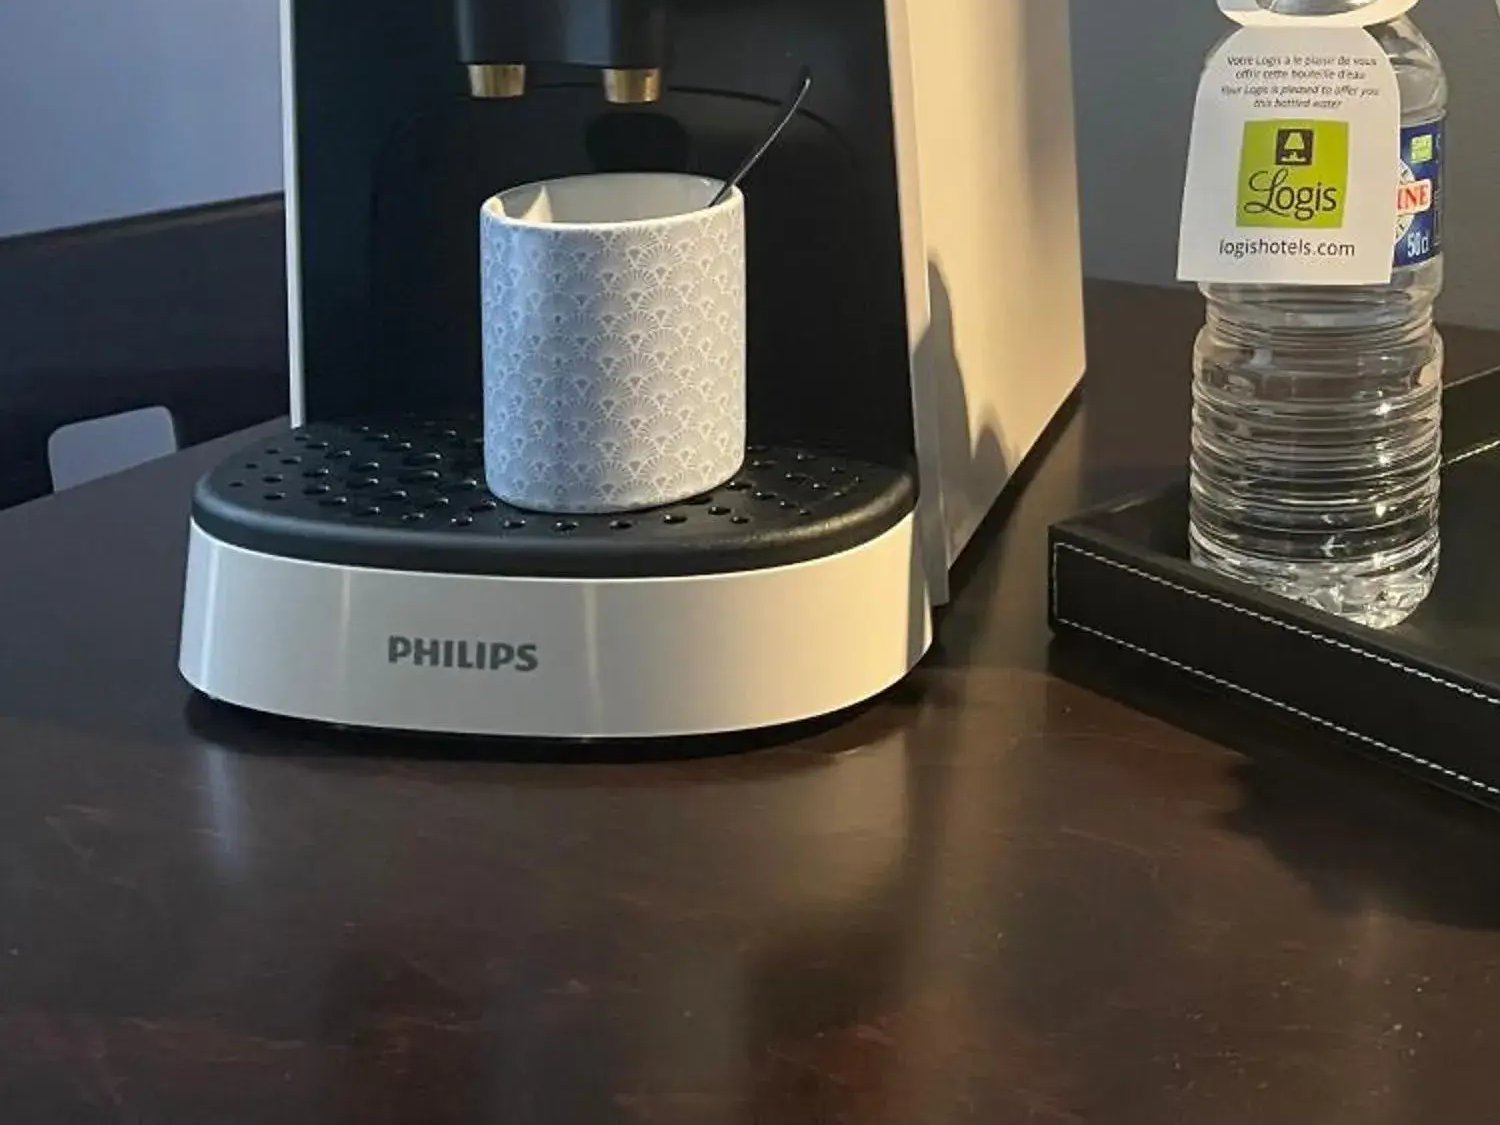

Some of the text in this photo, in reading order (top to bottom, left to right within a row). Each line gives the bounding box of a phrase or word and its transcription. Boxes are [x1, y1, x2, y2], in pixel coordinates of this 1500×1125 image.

[1243, 168, 1338, 221] Logis
[1219, 237, 1356, 259] logishotels.com
[388, 634, 539, 672] PHILIPS
